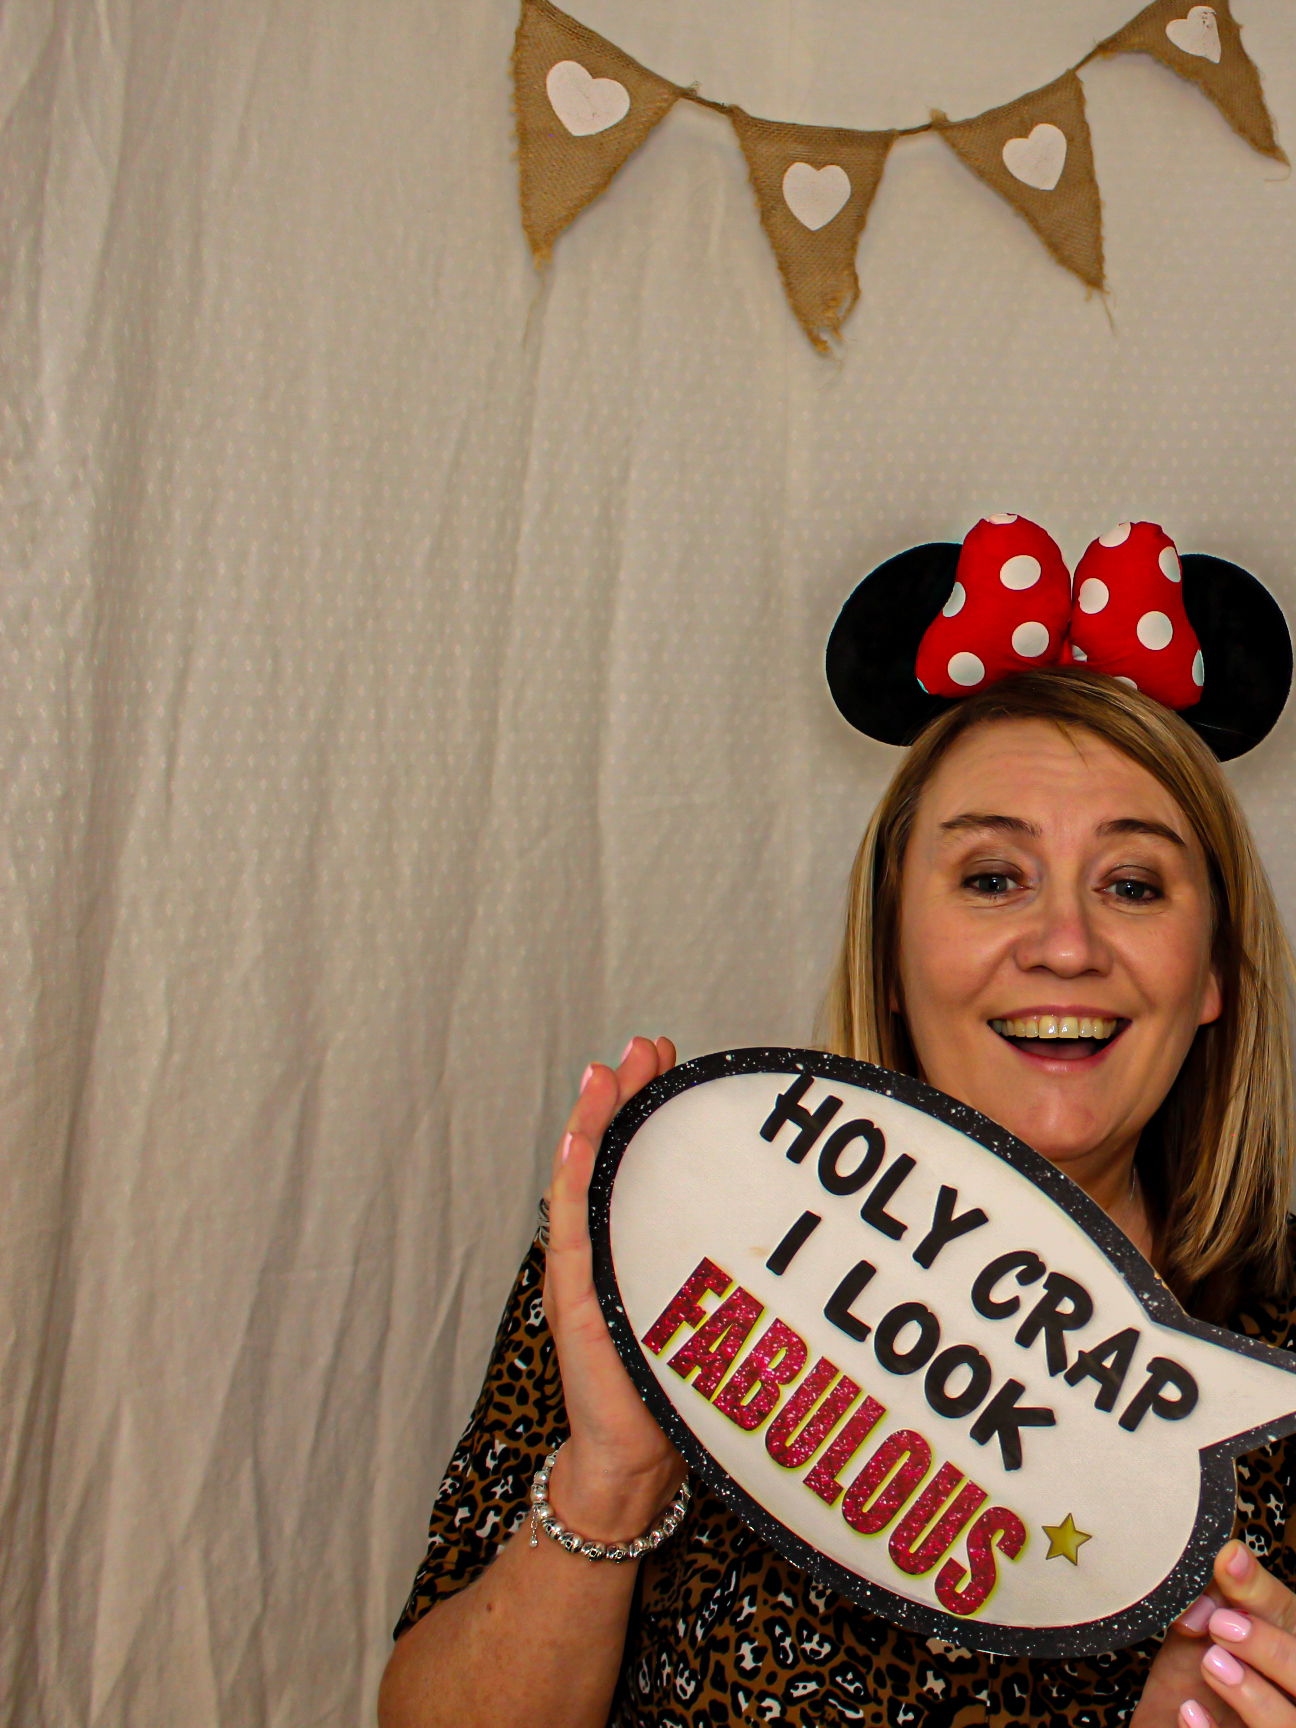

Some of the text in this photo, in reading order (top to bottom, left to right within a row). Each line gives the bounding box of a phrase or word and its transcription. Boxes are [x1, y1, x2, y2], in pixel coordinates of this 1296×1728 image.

[760, 1074, 1200, 1431] HOLY CRAP
[765, 1210, 1055, 1470] I LOOK
[640, 1256, 1027, 1616] FABULOUS
